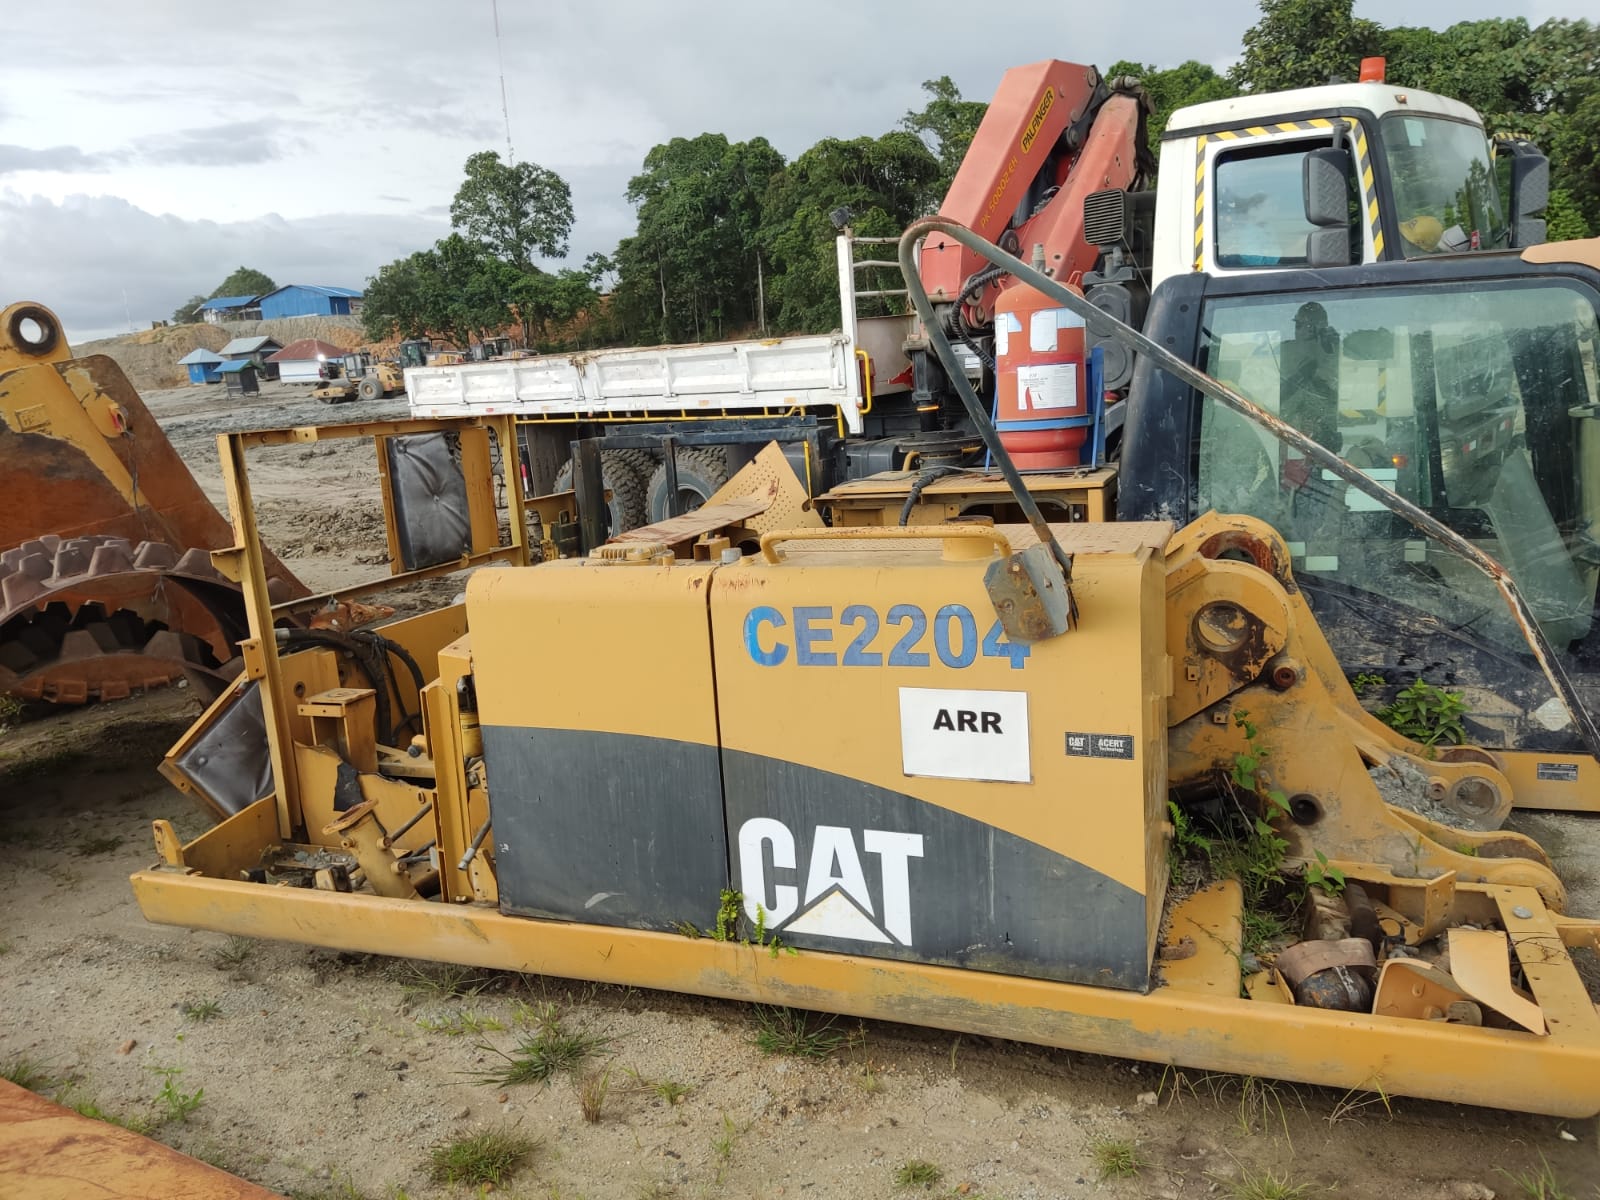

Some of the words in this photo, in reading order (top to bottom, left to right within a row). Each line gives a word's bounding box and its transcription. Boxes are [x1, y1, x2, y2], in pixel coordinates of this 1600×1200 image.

[1022, 90, 1053, 151] PALFINGER
[981, 214, 991, 228] PK
[743, 603, 1031, 670] CE2204
[933, 708, 1004, 734] ARR
[1068, 737, 1085, 747] CAT
[1098, 739, 1125, 748] ACERT
[738, 817, 925, 947] CAT
